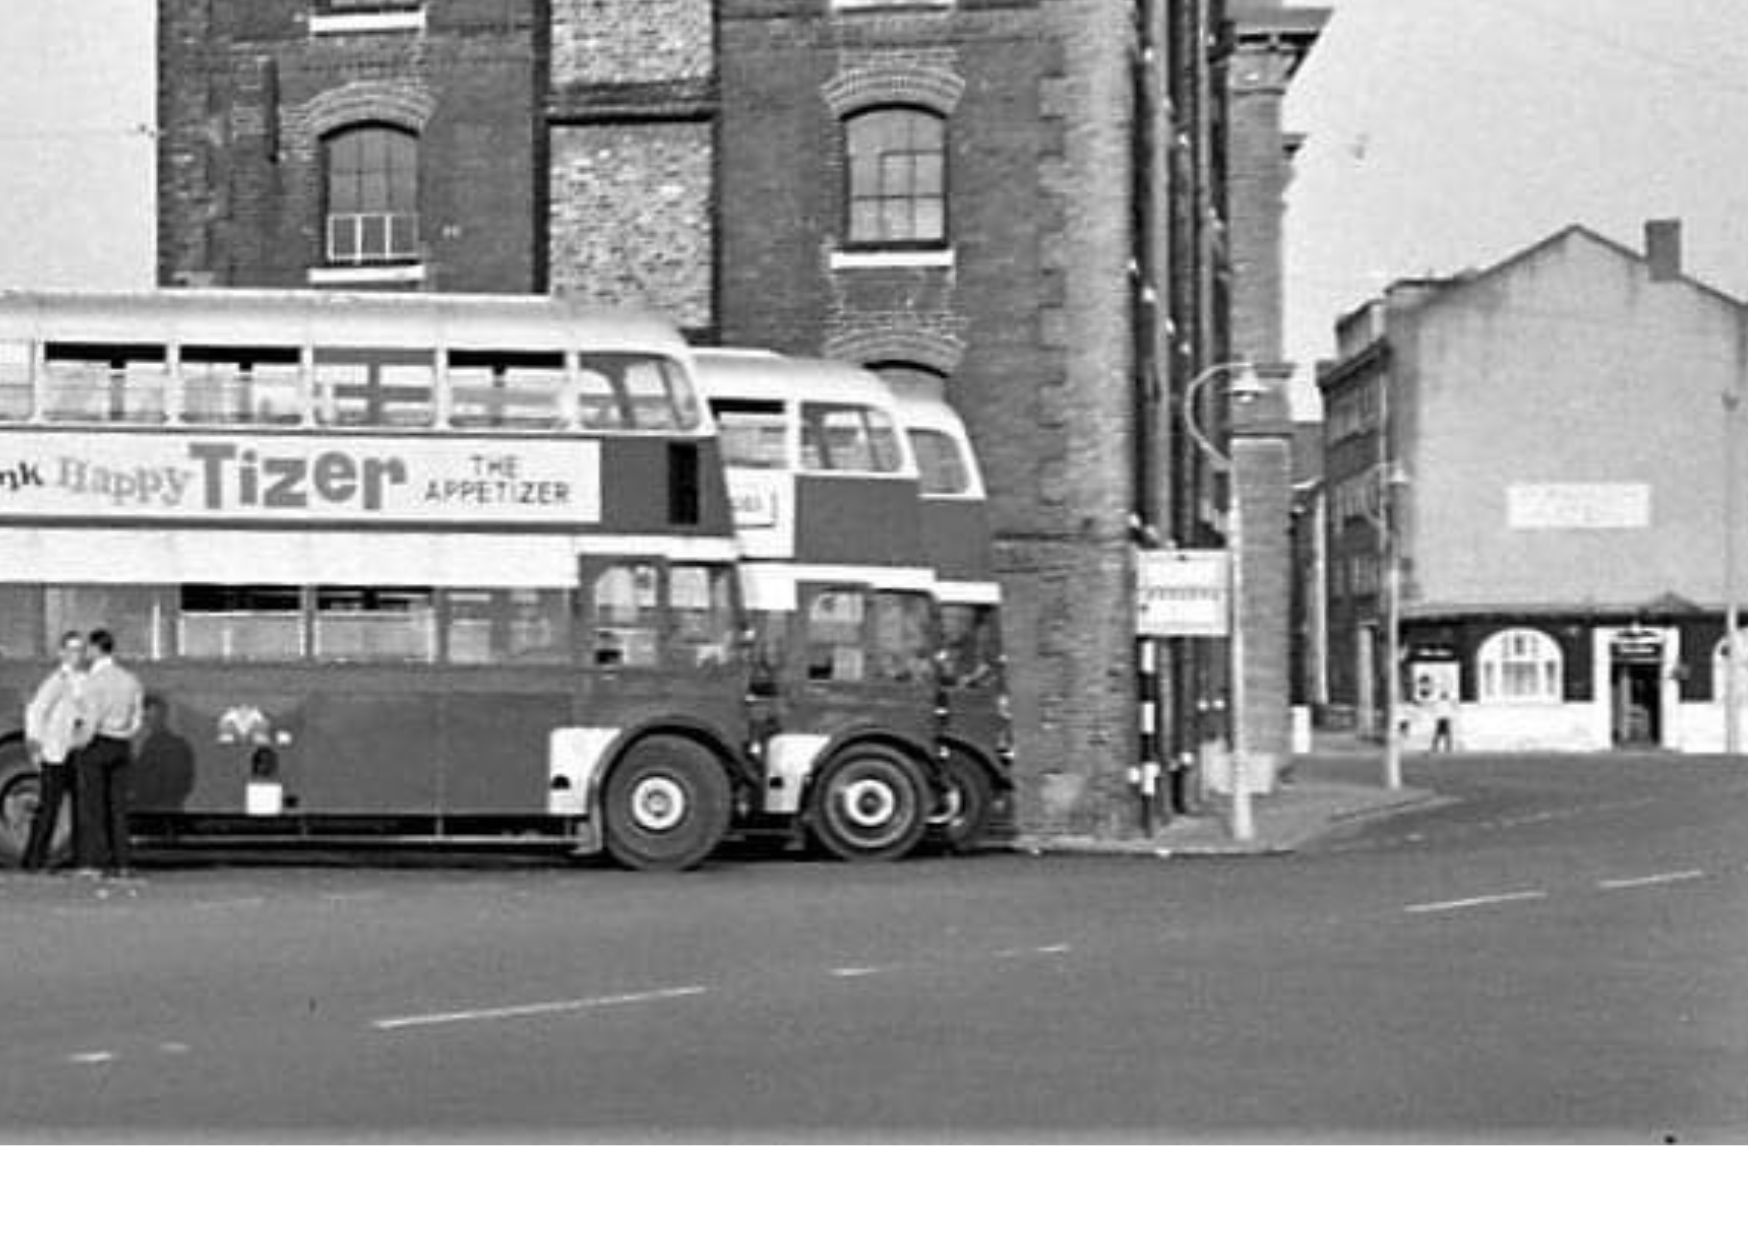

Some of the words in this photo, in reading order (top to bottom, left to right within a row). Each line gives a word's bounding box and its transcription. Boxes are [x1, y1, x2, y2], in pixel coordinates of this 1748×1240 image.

[56, 457, 194, 506] Happy
[188, 441, 408, 511] Tizer
[468, 454, 520, 479] THE
[424, 479, 571, 505] APPETIZER
